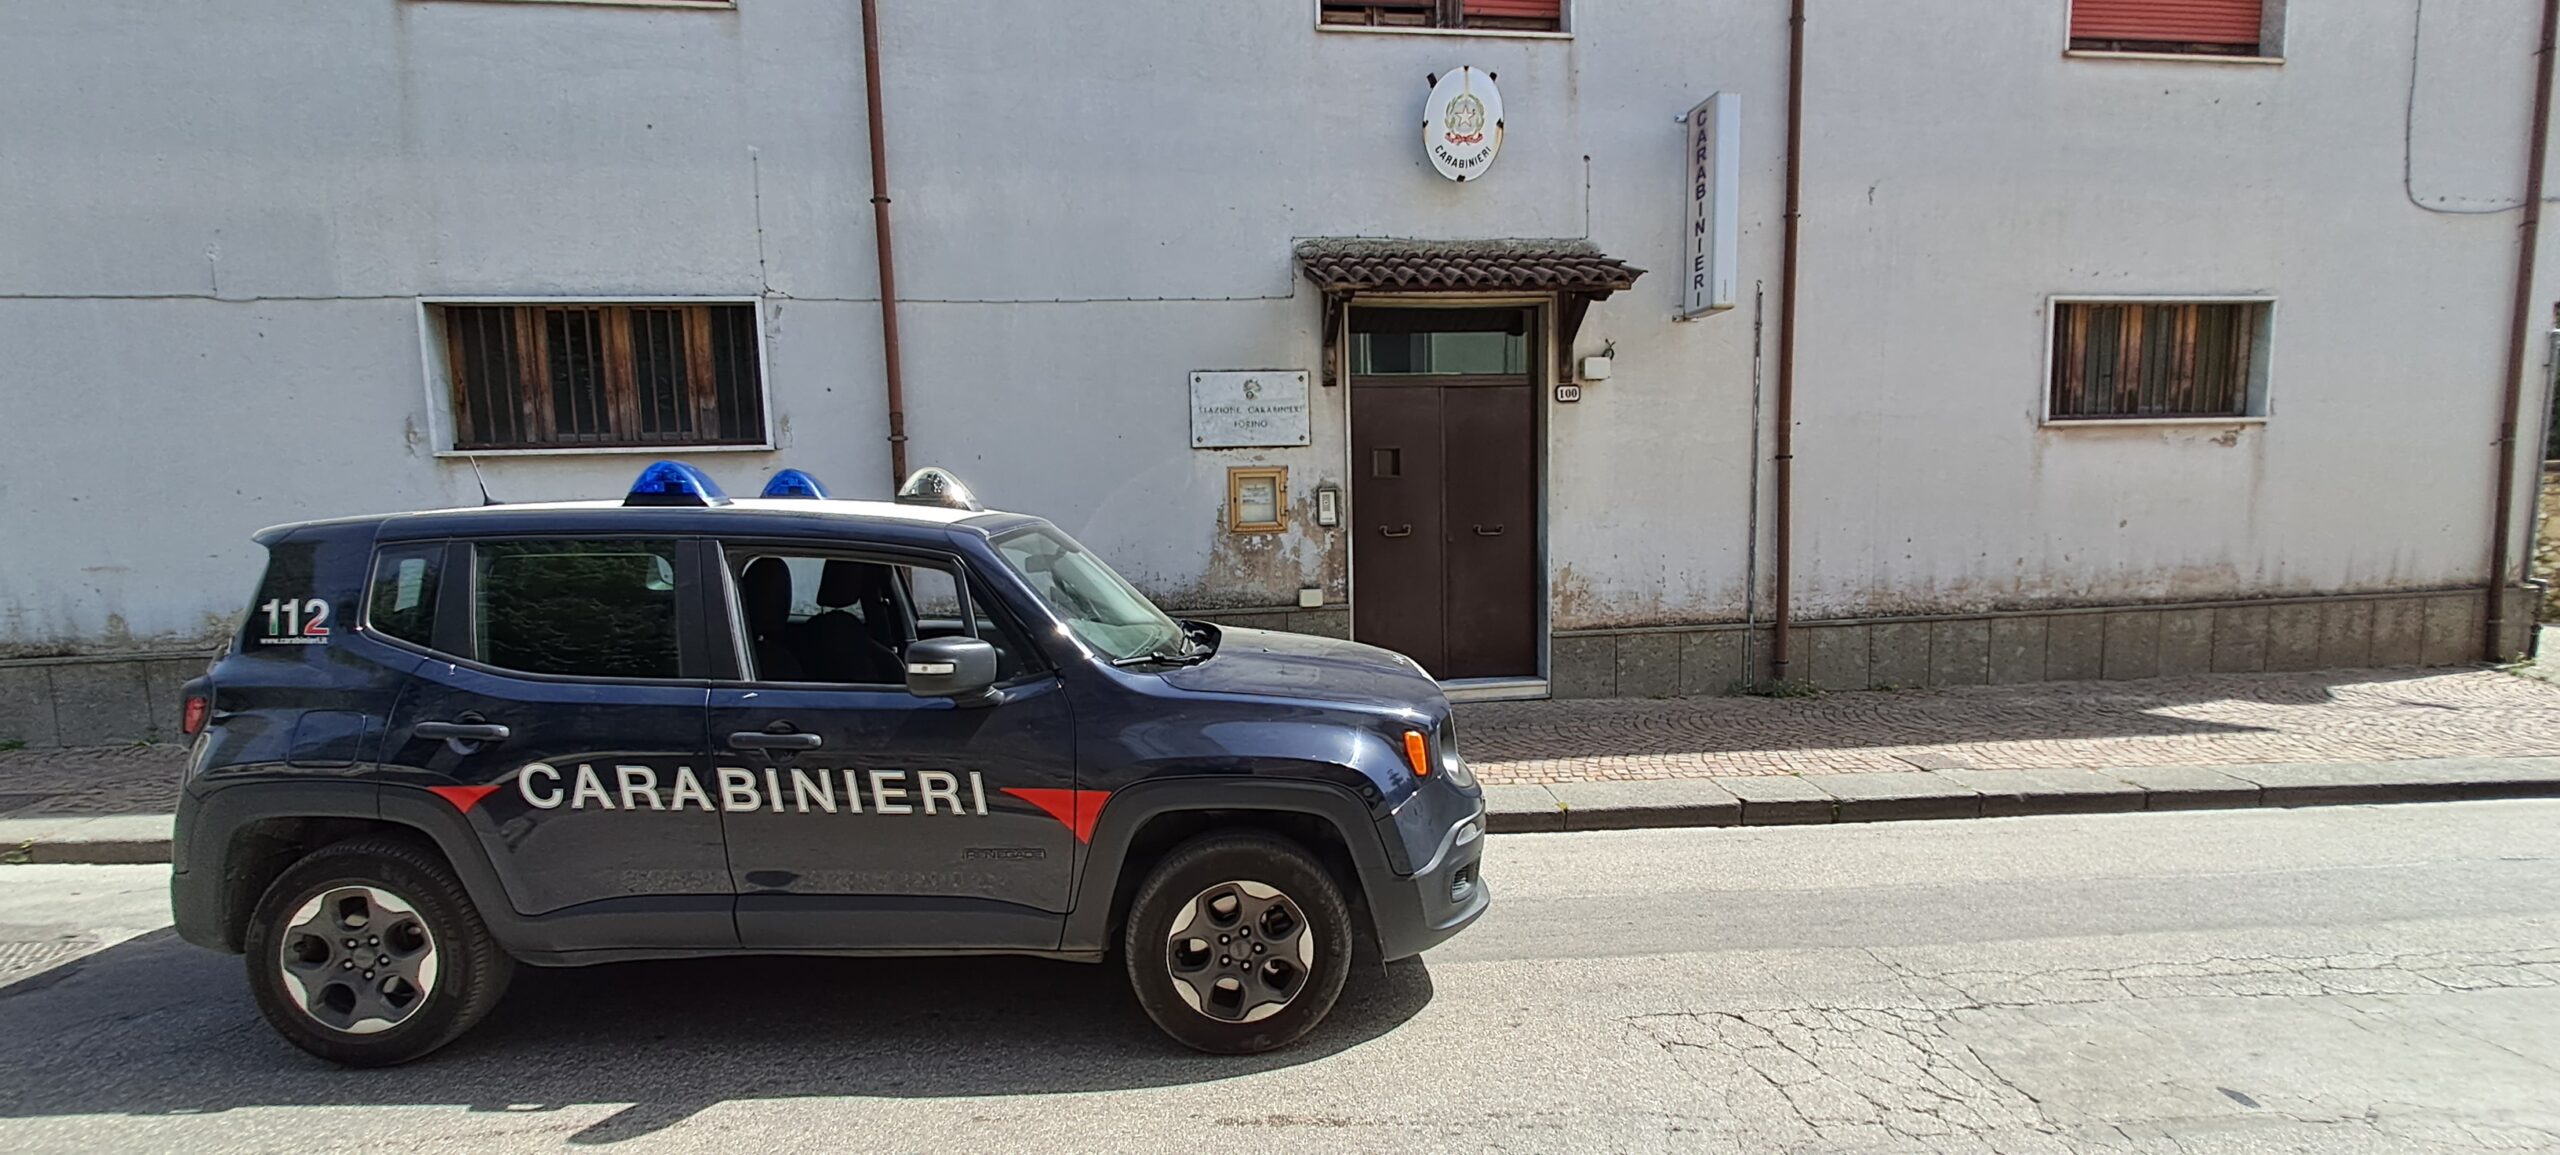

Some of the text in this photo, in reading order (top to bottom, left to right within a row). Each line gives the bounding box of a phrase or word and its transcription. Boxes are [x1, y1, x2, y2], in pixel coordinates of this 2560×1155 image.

[1435, 145, 1491, 168] CARABINIERI
[1694, 109, 1707, 307] CARABINIERI
[1560, 388, 1578, 399] 100
[262, 598, 330, 636] 112
[518, 762, 989, 816] CARABINIERI
